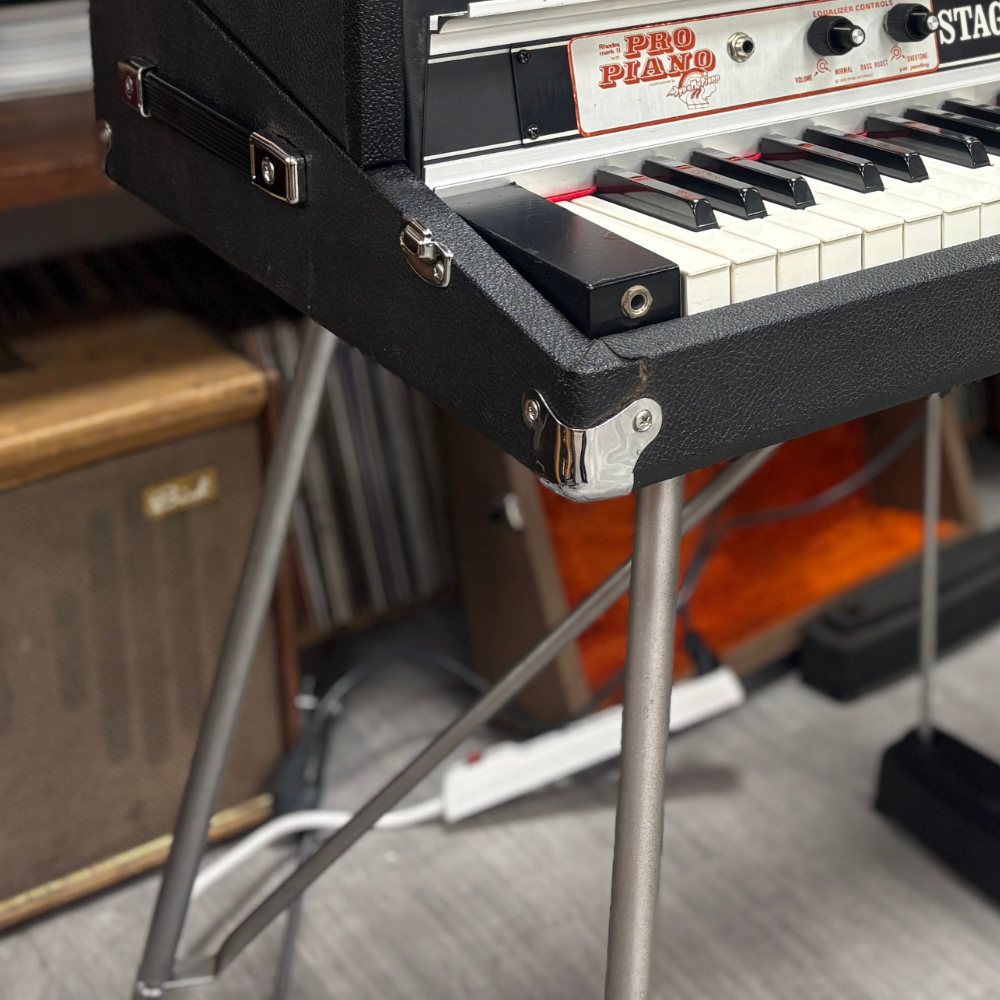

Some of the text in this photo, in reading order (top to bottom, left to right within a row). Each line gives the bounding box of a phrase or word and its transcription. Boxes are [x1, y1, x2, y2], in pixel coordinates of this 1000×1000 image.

[812, 0, 894, 18] EQUALIZER CONTROLS
[598, 42, 620, 50] Rhodes
[623, 27, 696, 60] PRO
[906, 53, 928, 63] OVERTONE
[598, 48, 717, 90] PIANO
[834, 66, 853, 75] NORMAL
[860, 60, 889, 71] BASS BOOST
[910, 62, 930, 71] pending
[795, 74, 813, 84] VOLUME
